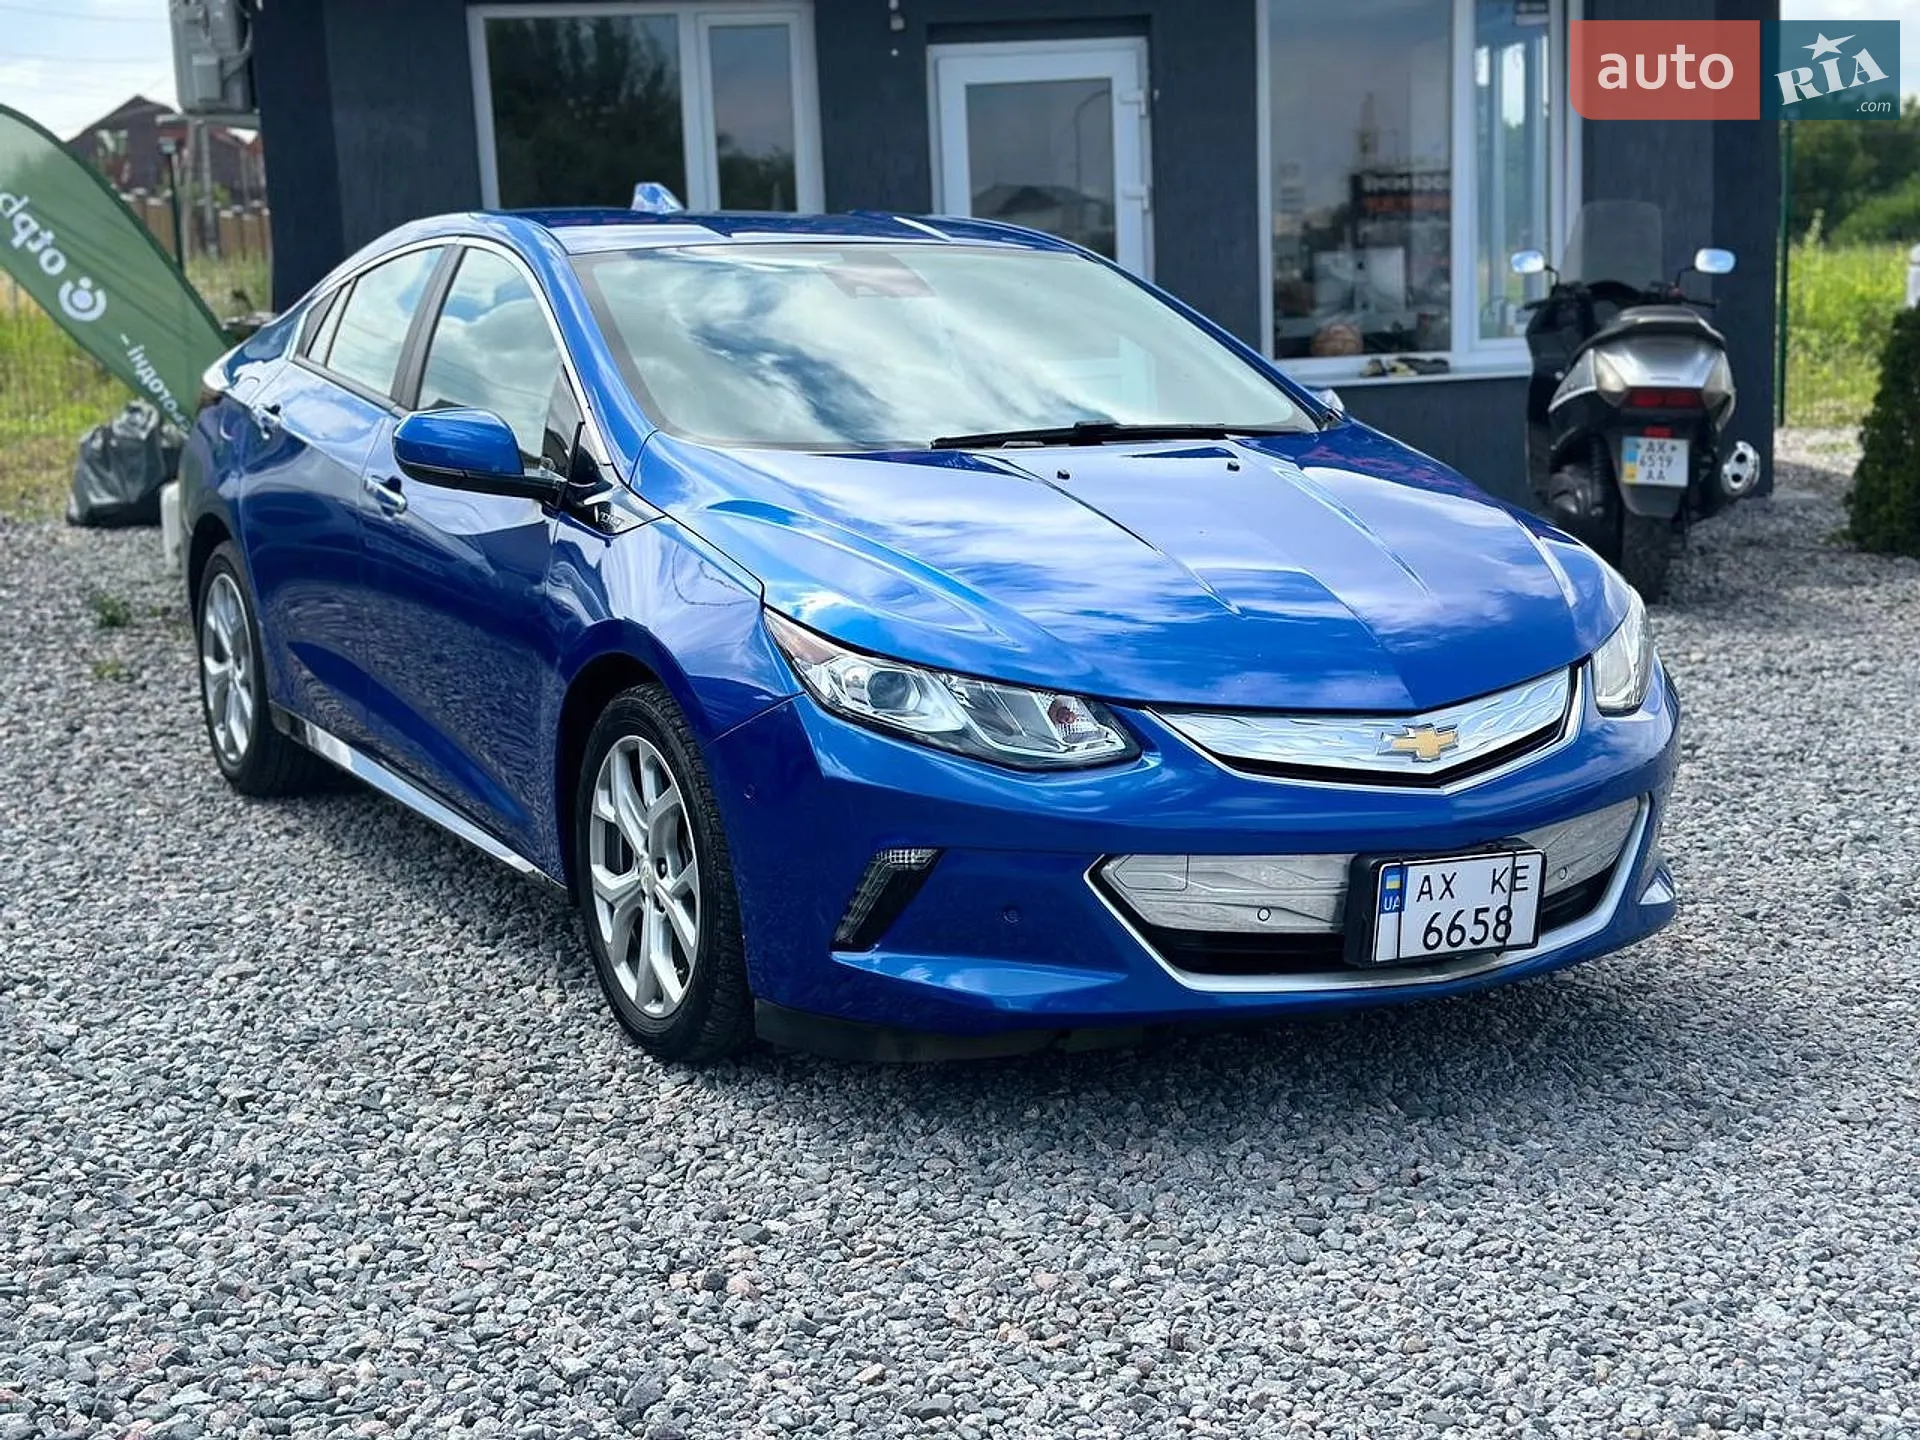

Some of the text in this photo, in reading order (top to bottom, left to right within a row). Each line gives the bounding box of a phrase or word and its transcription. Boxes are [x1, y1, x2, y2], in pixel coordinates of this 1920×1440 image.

[1416, 865, 1529, 903] AX KE
[1383, 895, 1401, 912] UA
[1422, 905, 1513, 951] 6658
